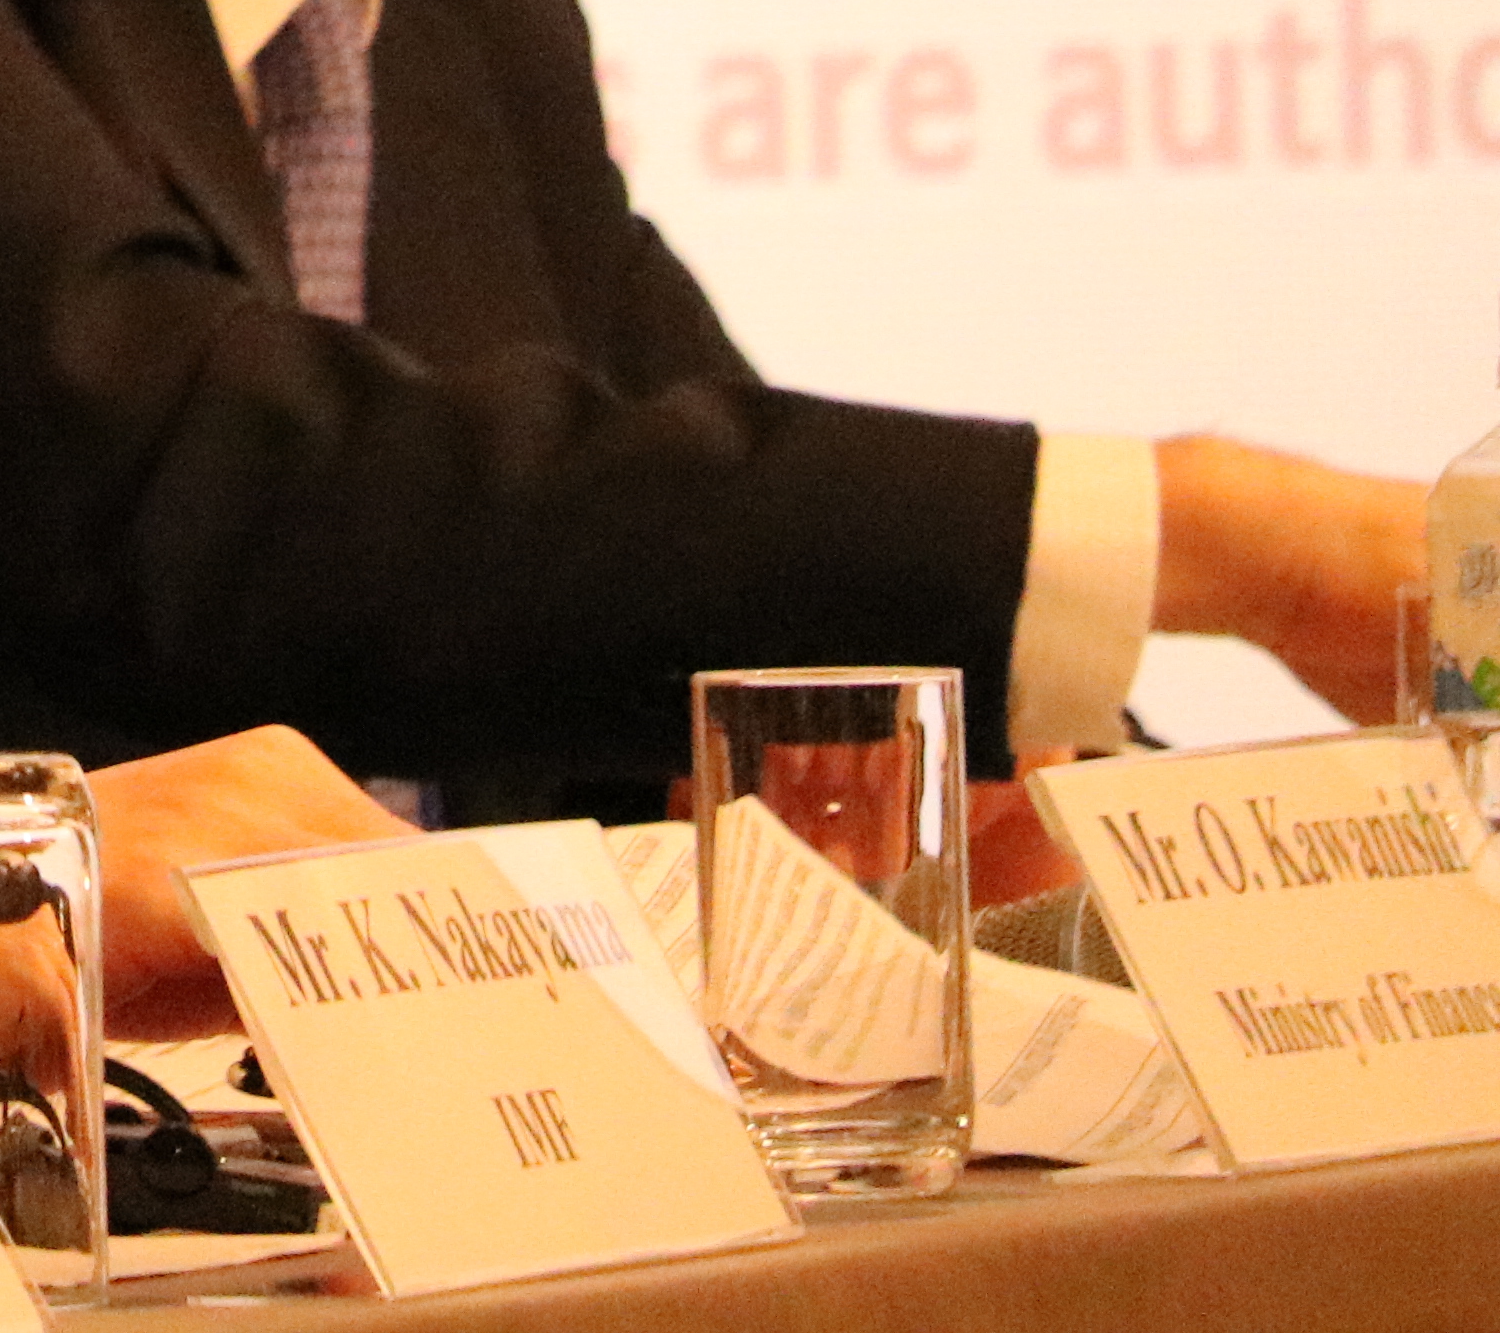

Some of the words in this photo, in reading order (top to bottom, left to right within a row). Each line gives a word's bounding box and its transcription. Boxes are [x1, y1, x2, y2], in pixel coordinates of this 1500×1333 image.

[700, 45, 977, 183] are
[1098, 810, 1209, 906] Mr.
[1193, 800, 1266, 895] O.
[1244, 781, 1472, 889] Kawanishi
[246, 909, 364, 1008] Mr.
[337, 896, 422, 995] K.
[395, 887, 635, 1004] Nakayama
[1214, 981, 1369, 1068] Ministry
[1357, 973, 1406, 1045] of
[490, 1087, 581, 1170] IMF
